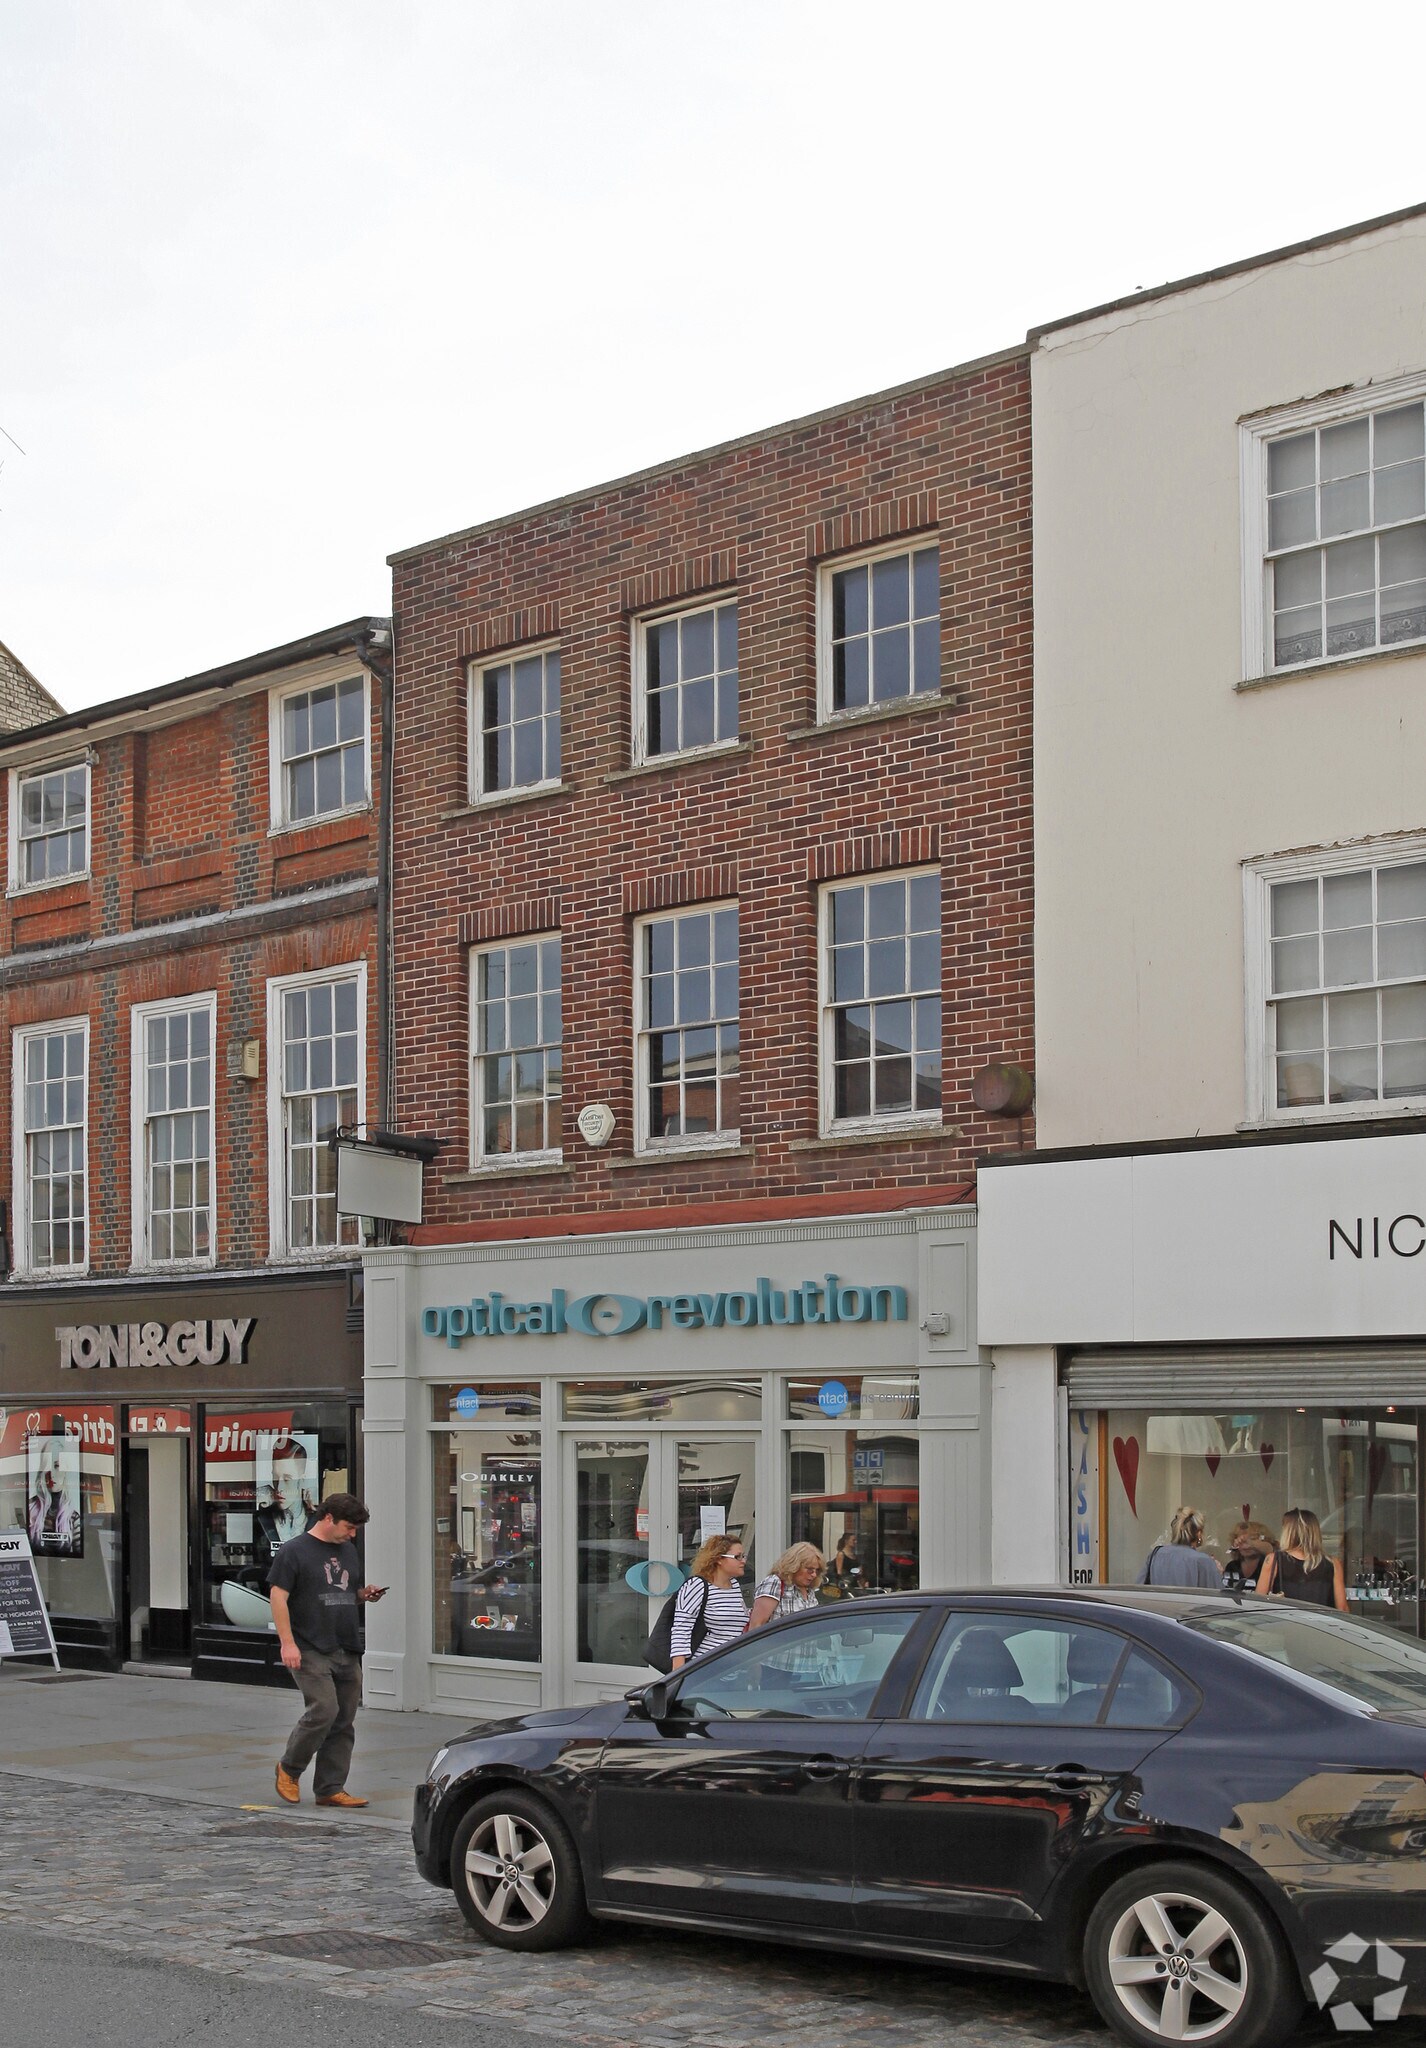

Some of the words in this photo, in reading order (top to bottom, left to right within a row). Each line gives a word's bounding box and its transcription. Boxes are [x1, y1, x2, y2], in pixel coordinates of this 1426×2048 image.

[1329, 1214, 1426, 1260] NIC
[422, 1287, 566, 1349] optical
[647, 1273, 908, 1329] revolution
[55, 1318, 254, 1369] TONI&GUY
[481, 1474, 533, 1482] OAKLEY
